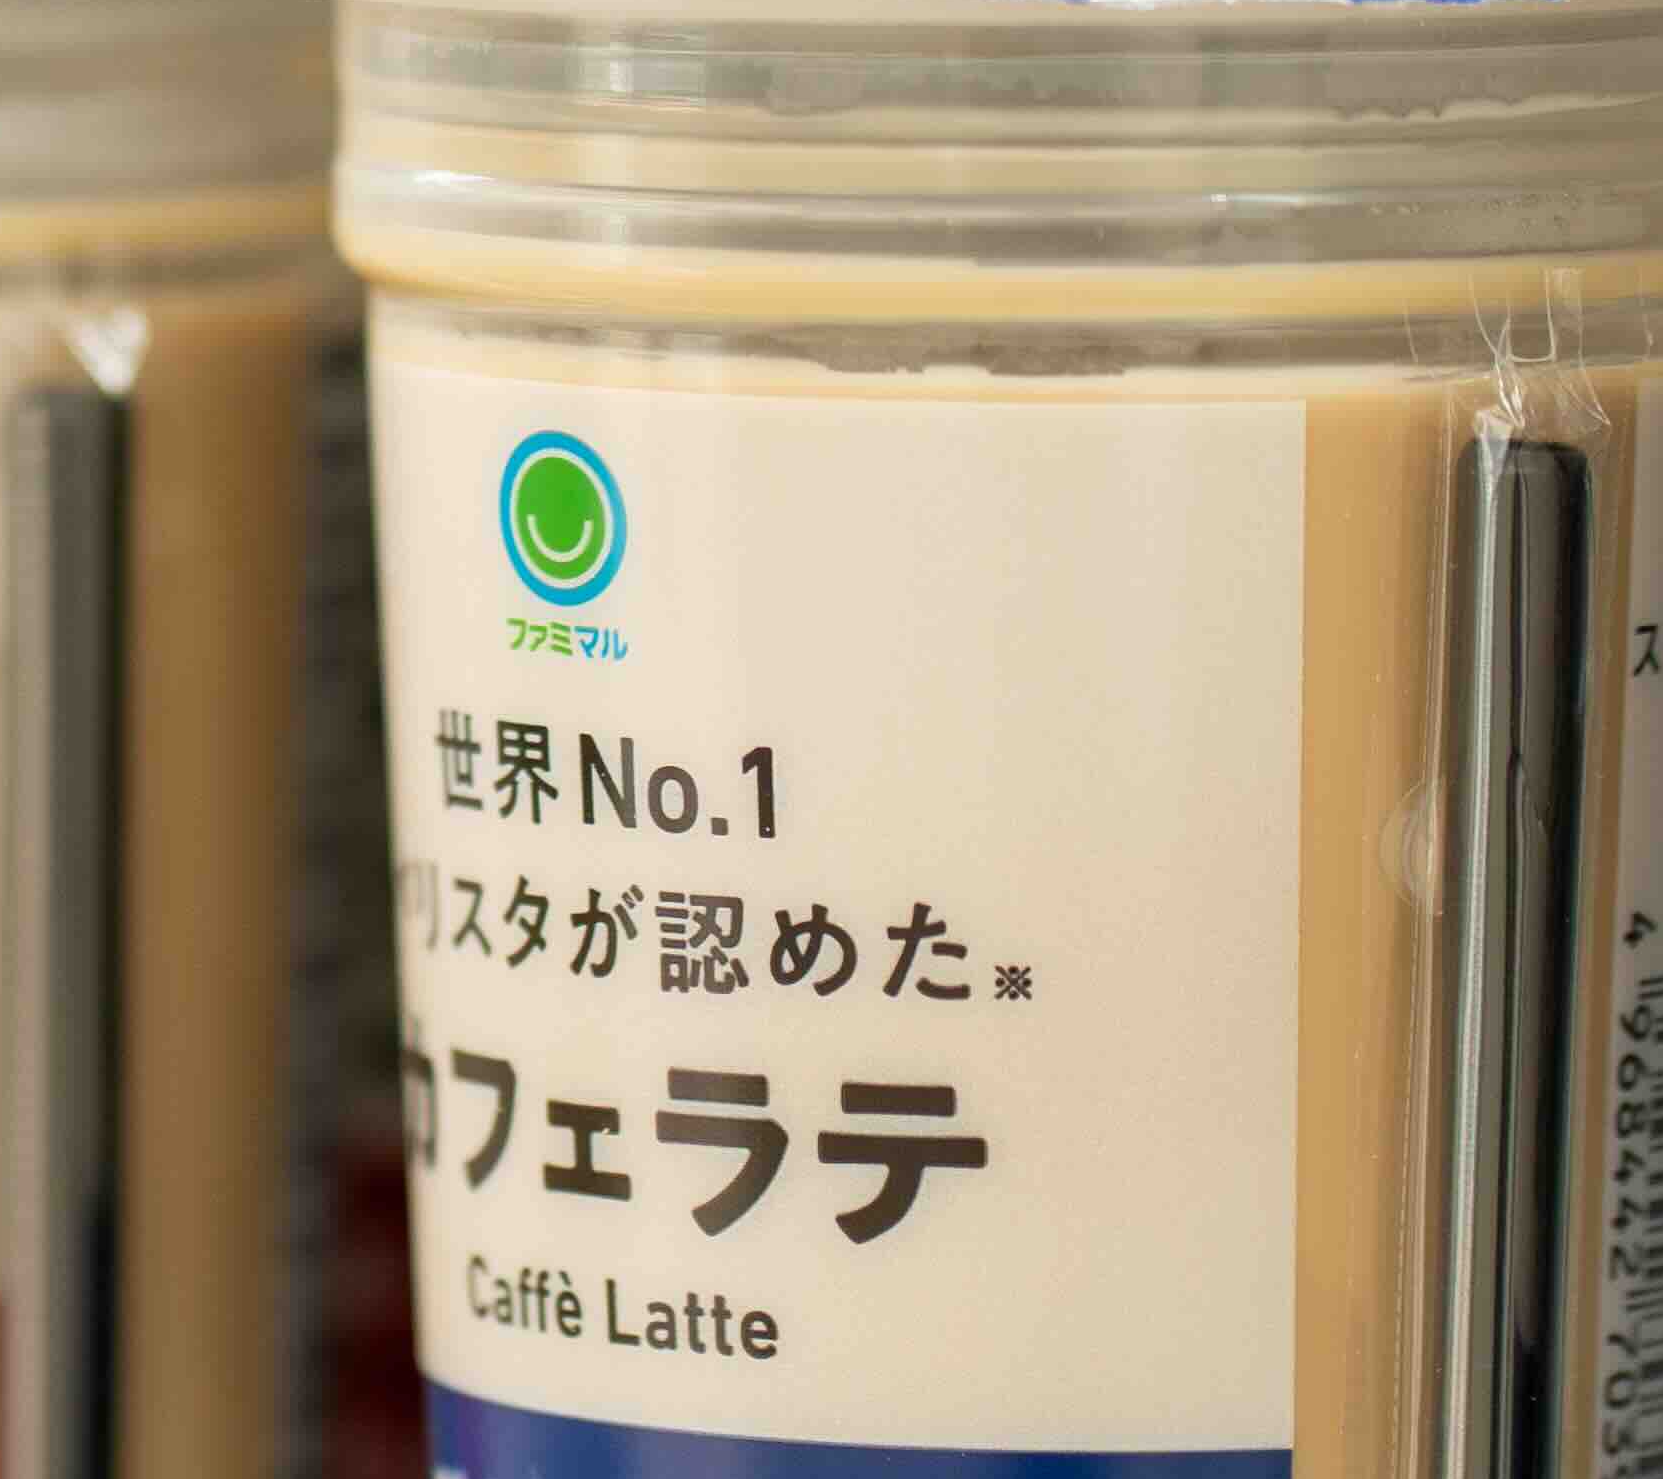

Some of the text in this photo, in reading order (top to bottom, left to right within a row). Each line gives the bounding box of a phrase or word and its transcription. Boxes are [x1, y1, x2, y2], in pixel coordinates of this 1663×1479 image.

[506, 616, 628, 660] ファミマル
[467, 1253, 780, 1361] Caffè Latte
